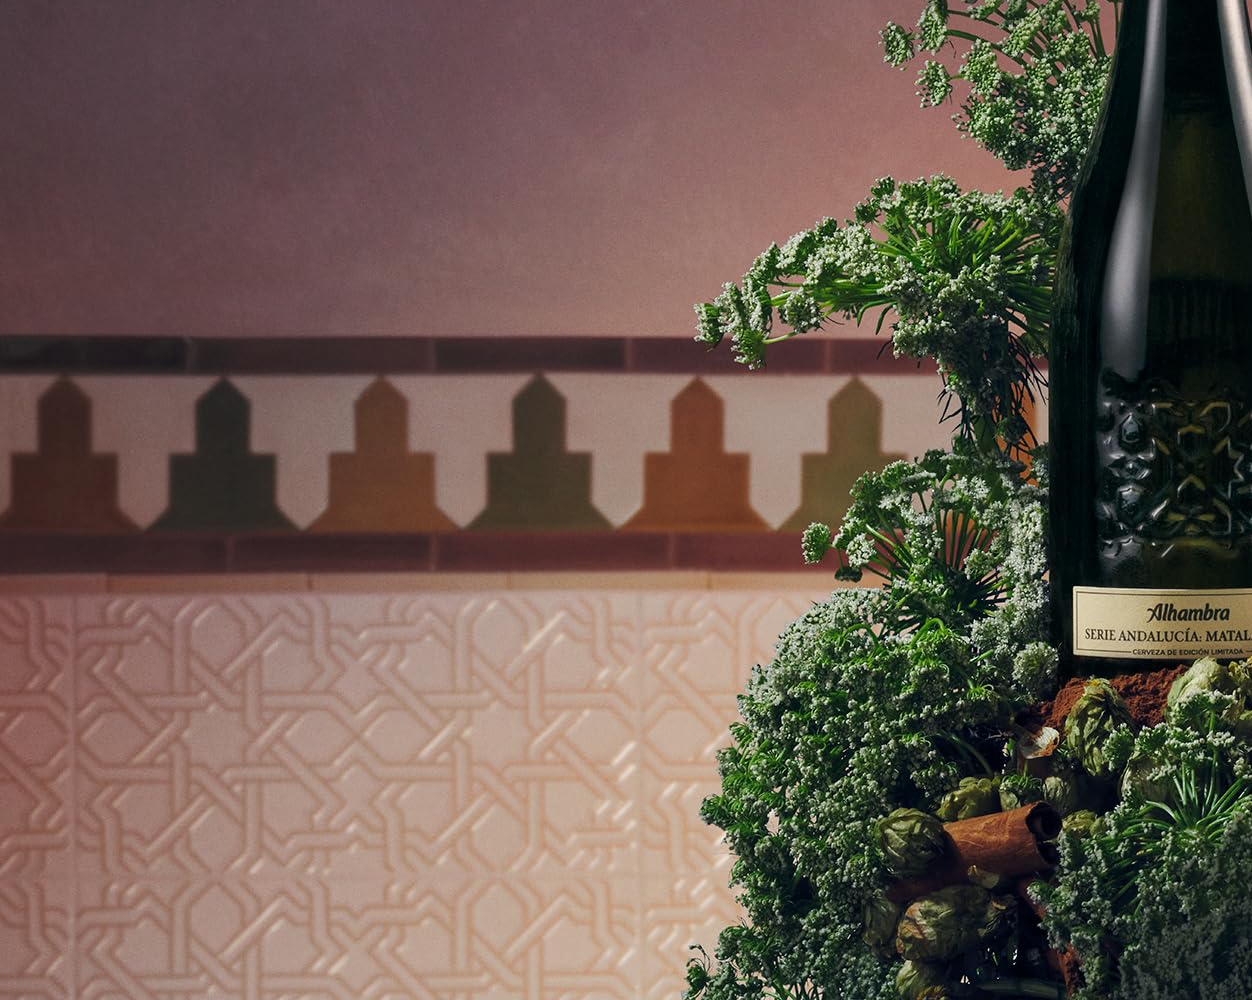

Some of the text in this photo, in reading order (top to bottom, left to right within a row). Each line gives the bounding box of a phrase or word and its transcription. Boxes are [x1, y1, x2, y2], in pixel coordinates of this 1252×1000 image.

[1146, 603, 1230, 623] Alhambra
[1084, 628, 1116, 641] SERIE
[1118, 627, 1202, 643] ANDALUCÍA:
[1179, 647, 1210, 656] EDICIÓN
[1211, 648, 1244, 656] LIMITADA
